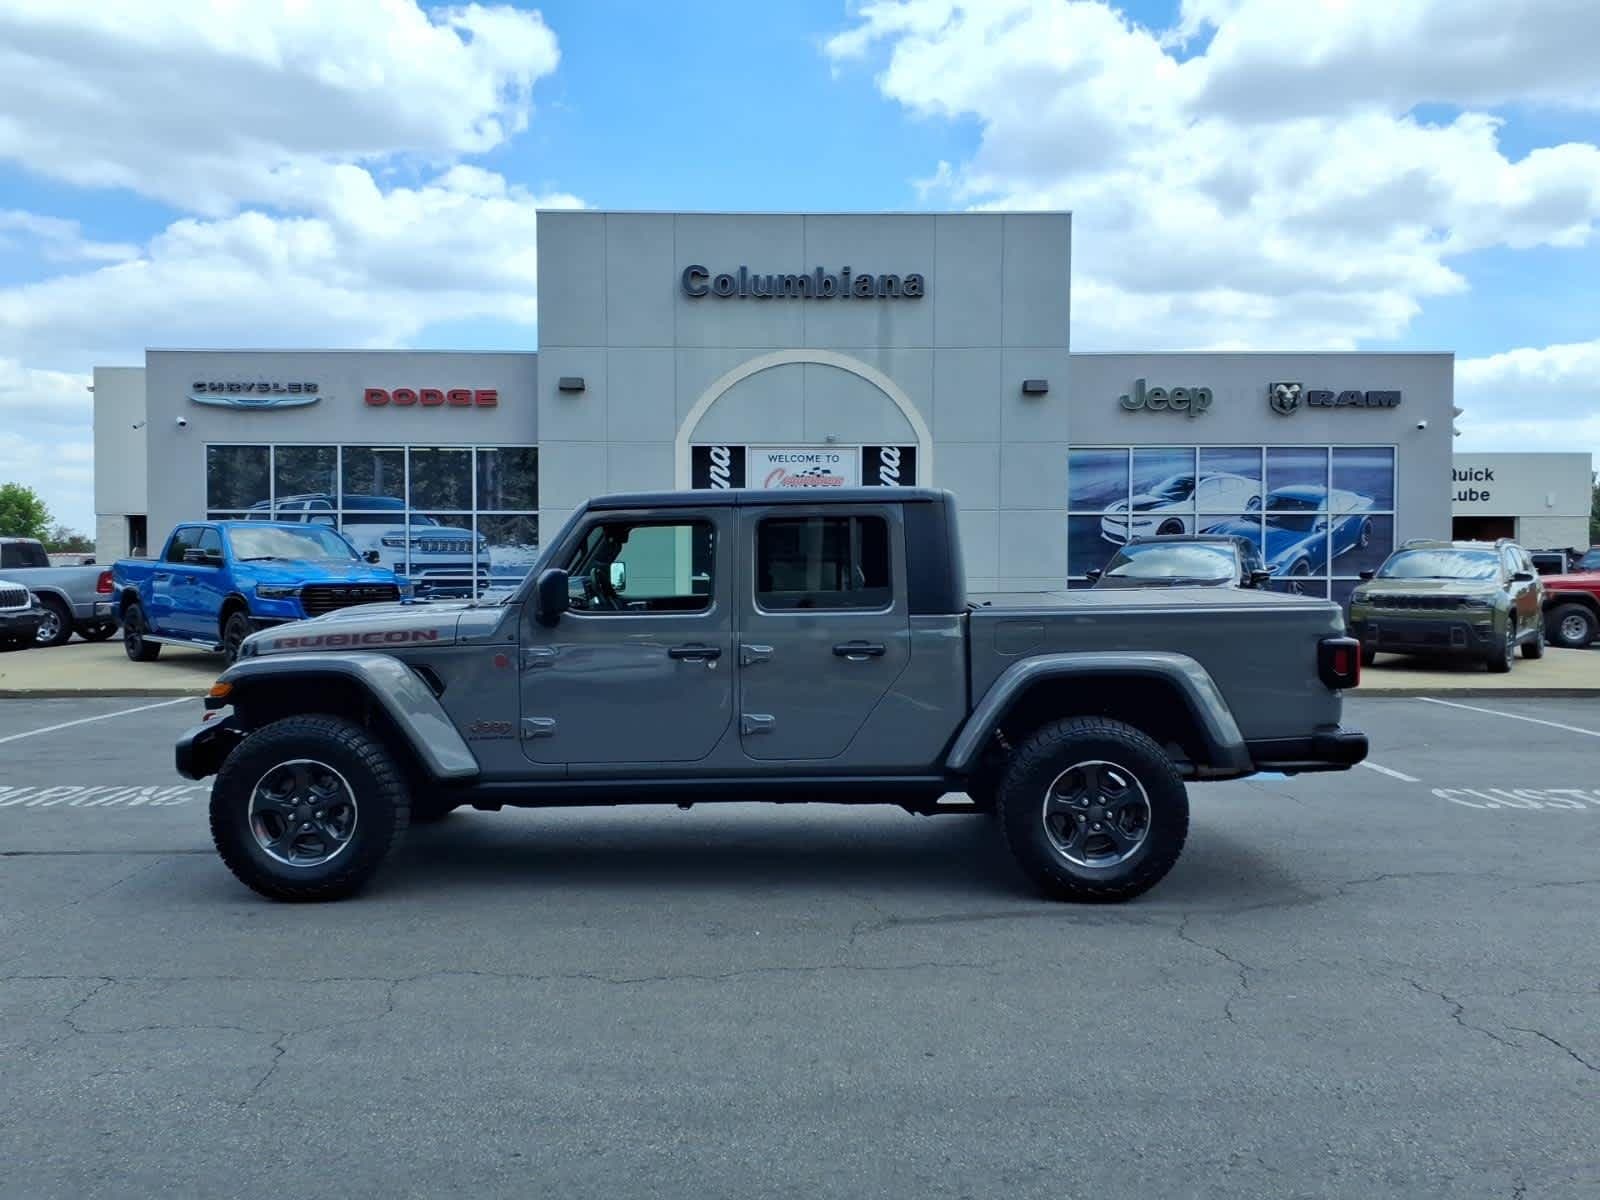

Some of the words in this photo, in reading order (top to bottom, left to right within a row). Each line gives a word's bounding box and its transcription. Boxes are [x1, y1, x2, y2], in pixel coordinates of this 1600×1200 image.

[682, 265, 923, 297] Columbiana
[192, 382, 320, 392] CHRYSLER
[365, 388, 499, 406] DODGE
[1120, 378, 1213, 416] Jeep
[1307, 389, 1402, 408] RAM
[768, 455, 821, 463] WELCOME
[827, 455, 840, 463] TO
[274, 629, 436, 650] RUBICON
[1431, 788, 1600, 809] CUST
